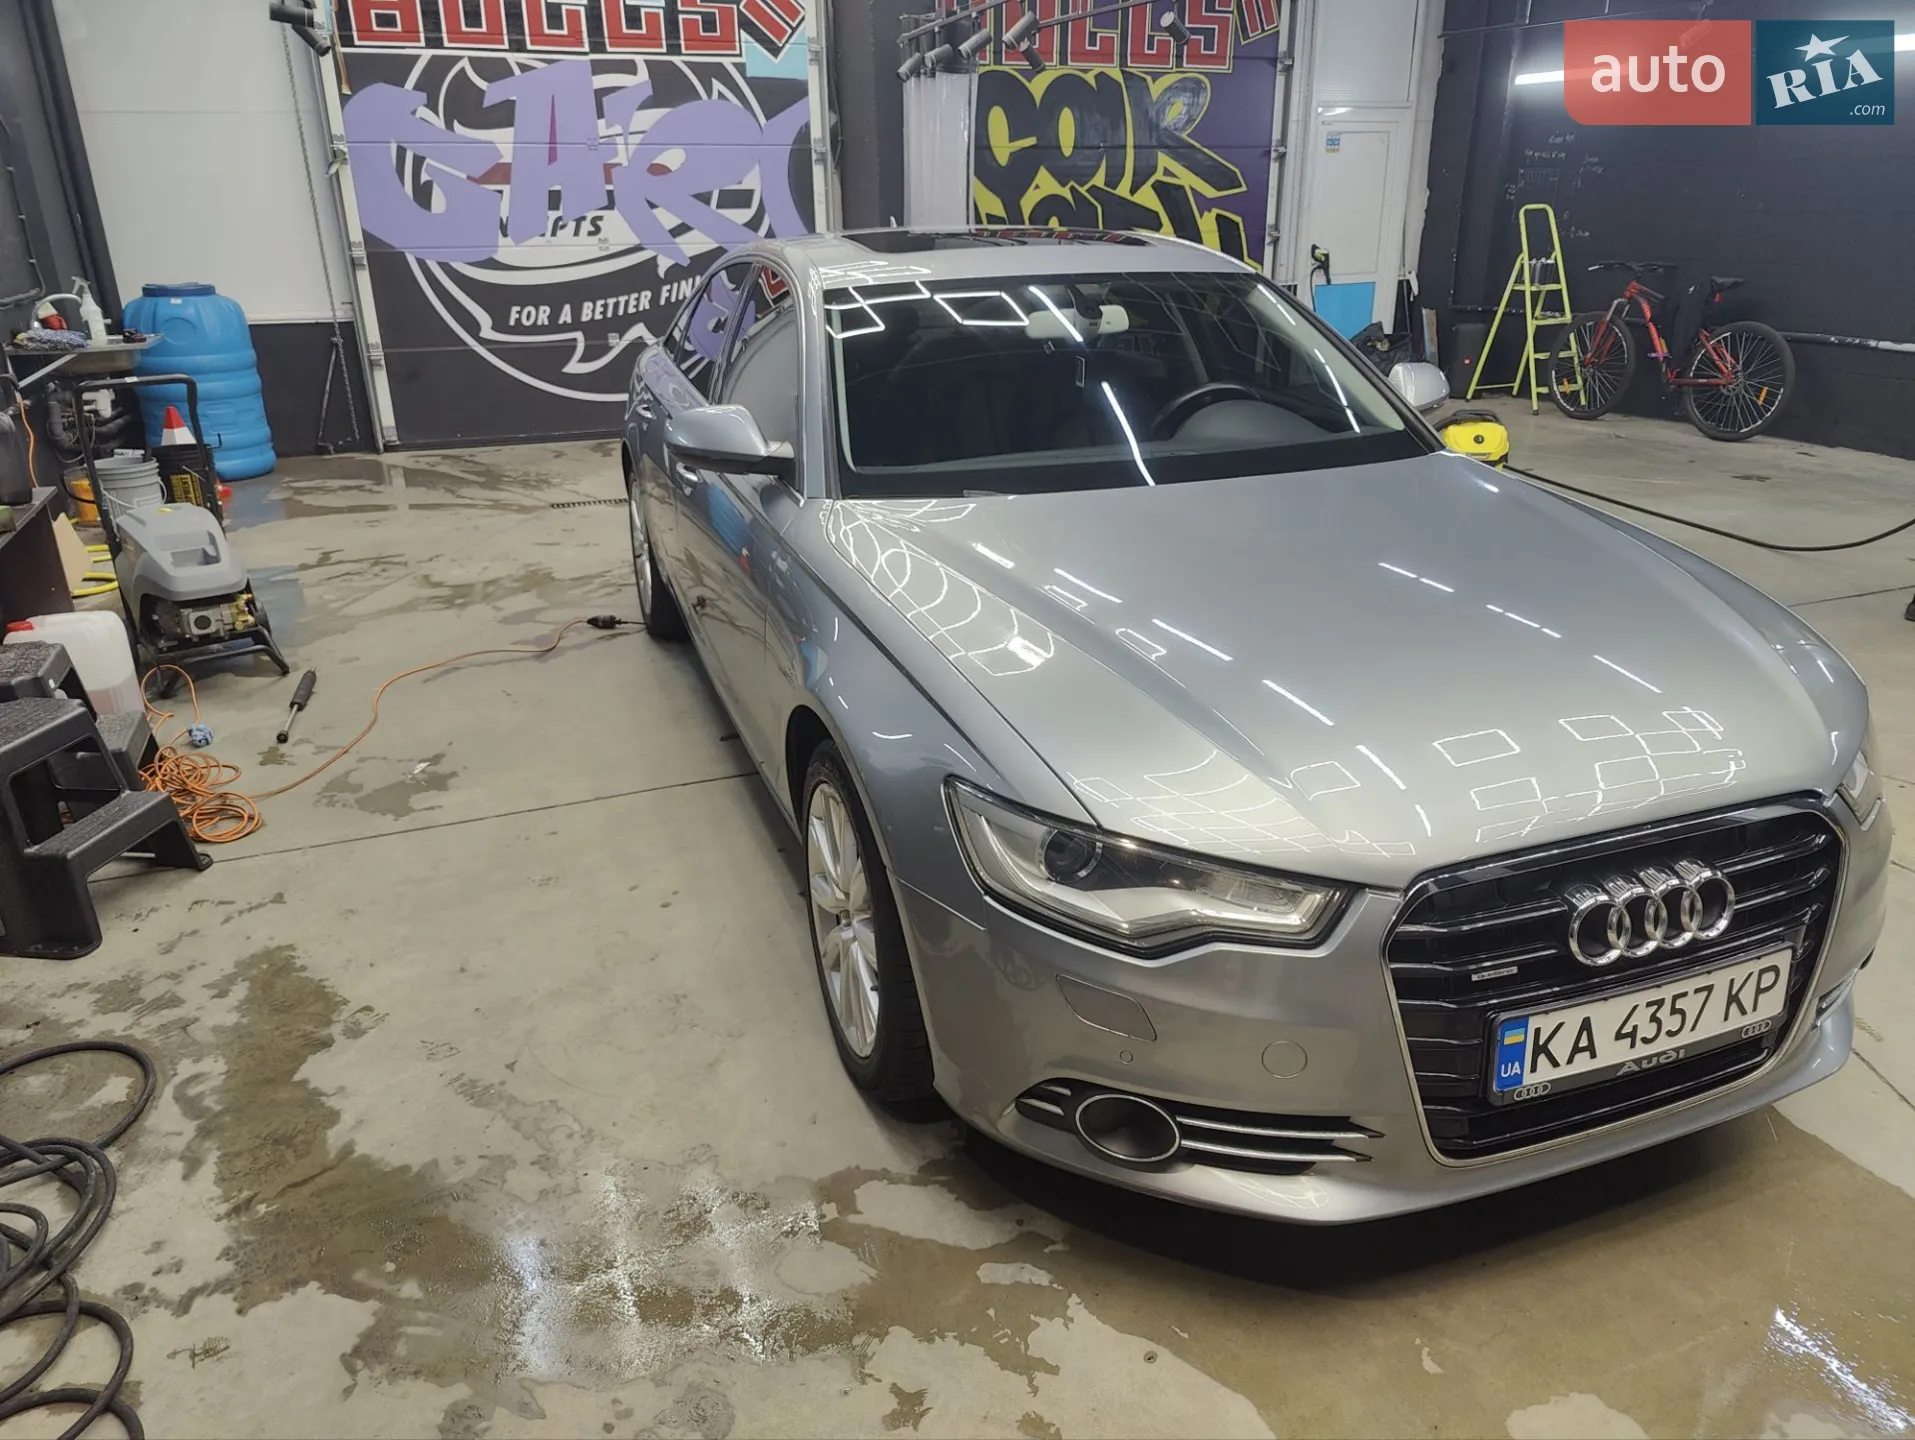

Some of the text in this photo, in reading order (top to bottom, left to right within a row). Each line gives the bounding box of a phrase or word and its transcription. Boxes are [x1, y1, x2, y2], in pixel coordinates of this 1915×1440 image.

[508, 304, 551, 327] FOR
[558, 304, 573, 325] A
[580, 290, 652, 322] BETTER
[1529, 963, 1782, 1074] KA 4357 KP
[1500, 1061, 1522, 1078] UA
